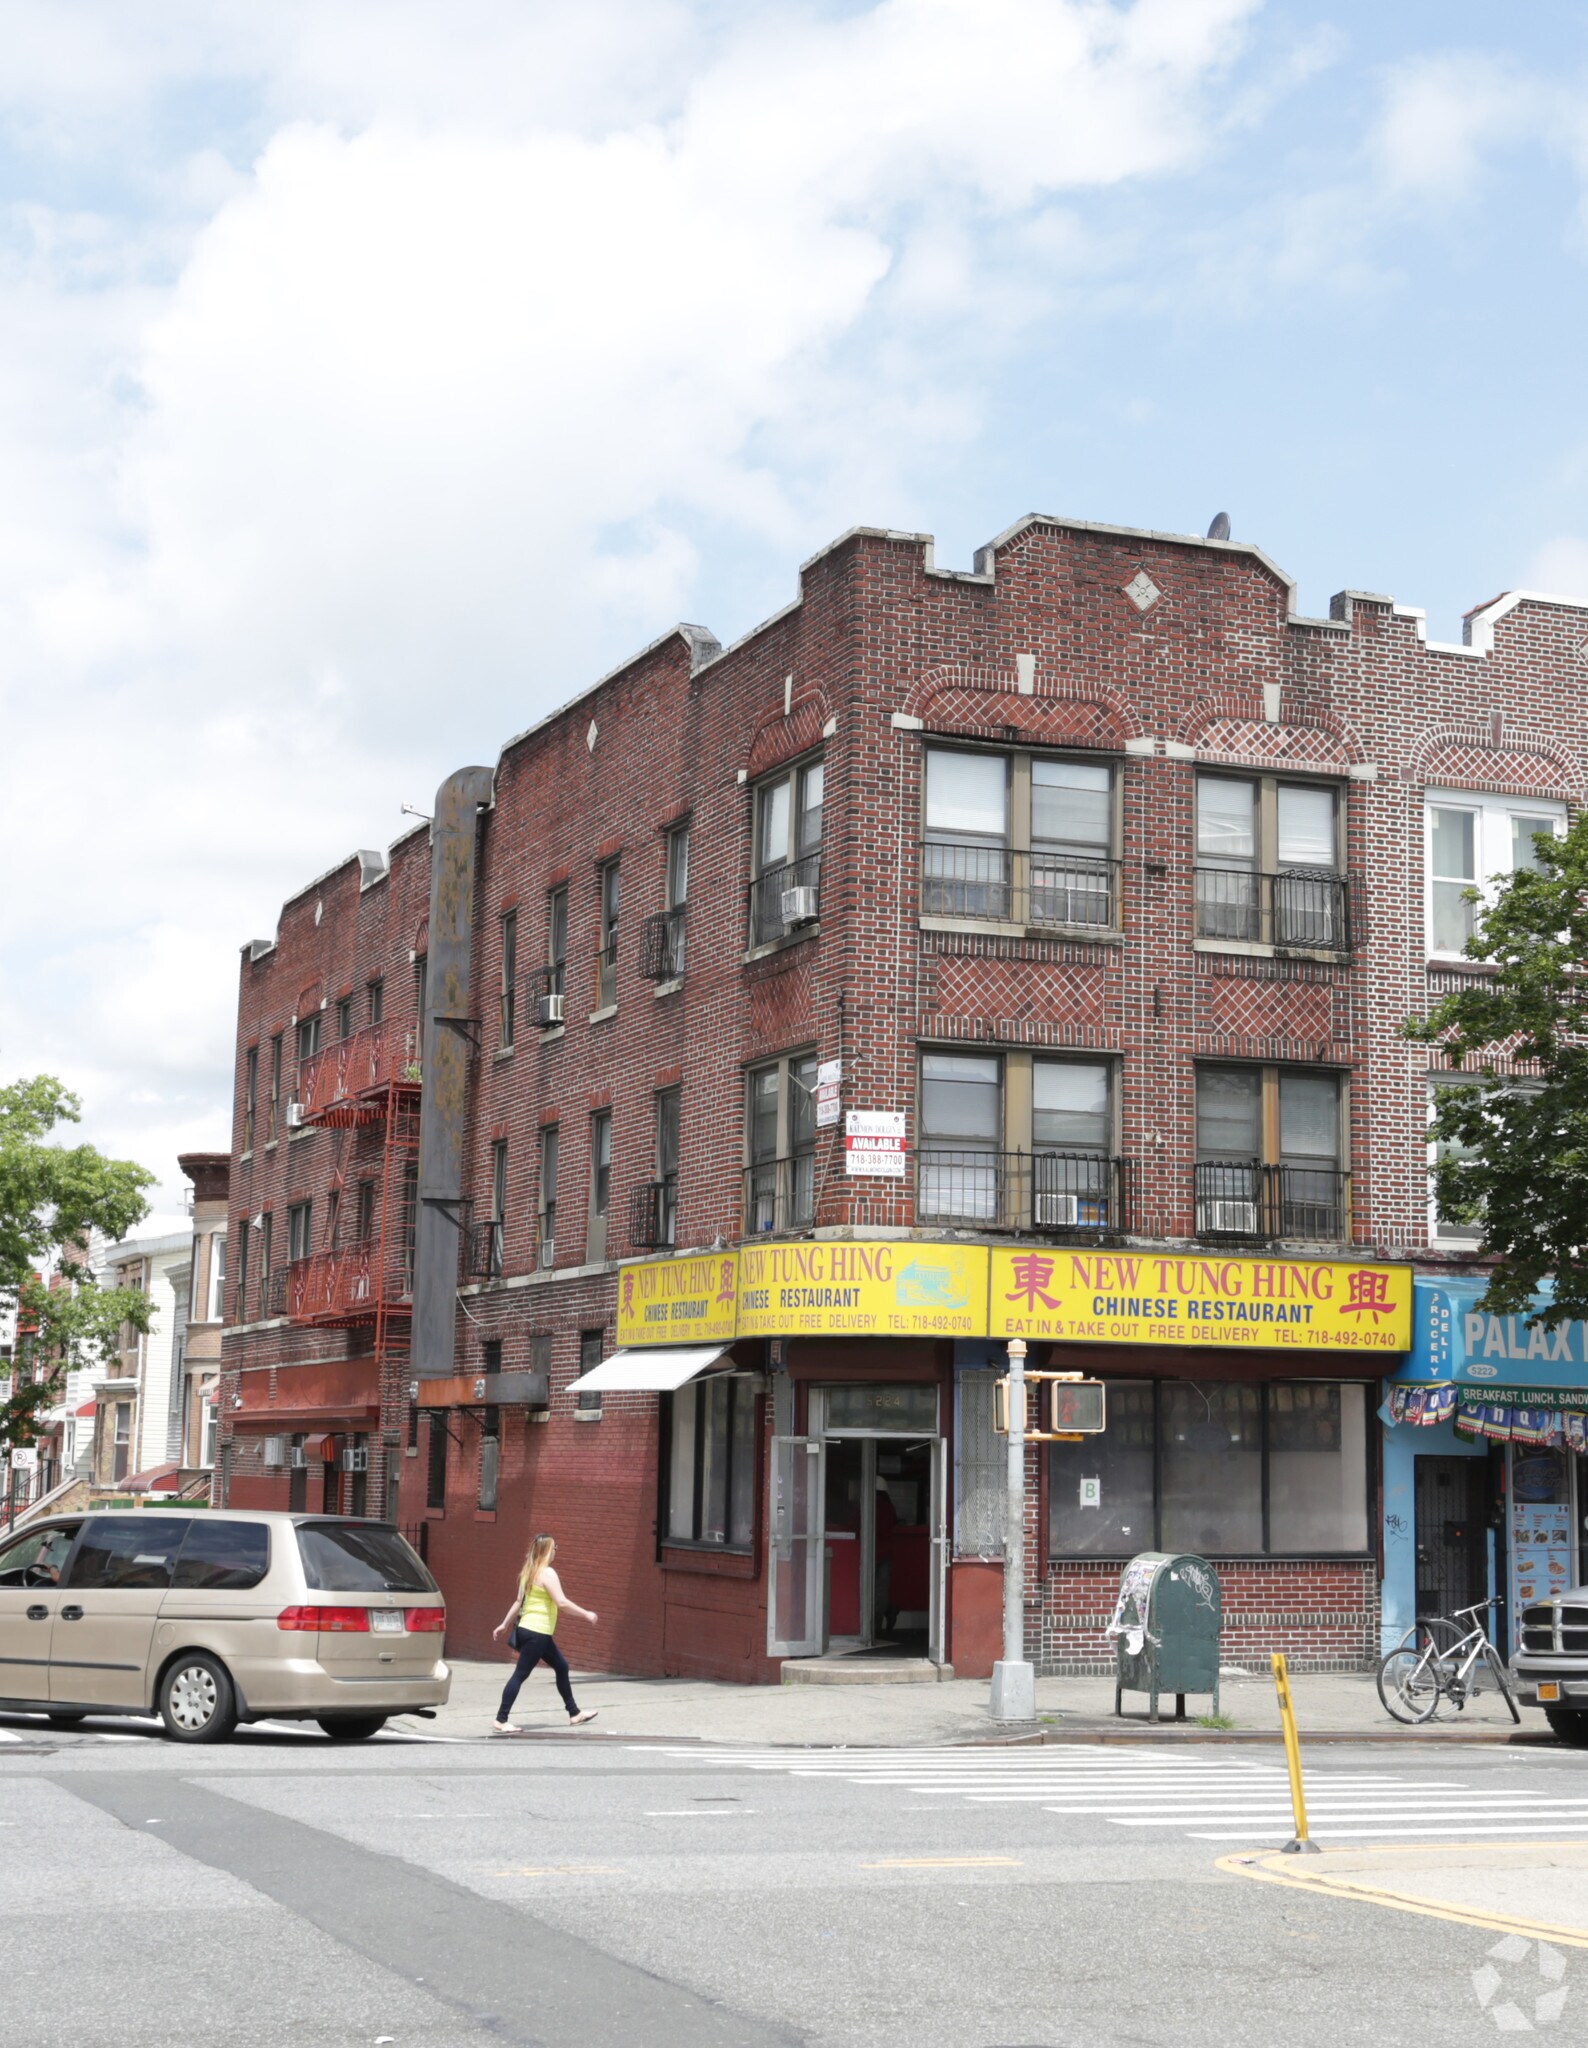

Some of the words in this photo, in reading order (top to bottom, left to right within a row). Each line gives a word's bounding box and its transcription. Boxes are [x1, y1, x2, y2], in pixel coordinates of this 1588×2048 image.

[851, 1154, 902, 1165] 718-388-7700
[637, 1266, 659, 1299] NEW
[661, 1262, 688, 1297] TUNG
[689, 1259, 716, 1294] HING
[743, 1250, 767, 1285] NEW
[770, 1246, 824, 1282] TUNG
[829, 1246, 892, 1282] HING
[1005, 1252, 1062, 1313] 東
[1069, 1255, 1144, 1292] NEW
[1152, 1259, 1243, 1297] TUNG
[1252, 1264, 1333, 1300] HING
[621, 1271, 635, 1323] 東
[645, 1303, 668, 1322] CHINESE
[671, 1300, 708, 1320] RESTAURANT
[743, 1289, 769, 1310] CHINESE
[780, 1288, 860, 1308] RESTAURANT
[1093, 1295, 1178, 1318] CHINESE
[1187, 1300, 1313, 1324] RESTAURANT
[1339, 1269, 1397, 1325] 興
[759, 1315, 776, 1329] TAKE
[778, 1314, 794, 1328] OUT
[799, 1314, 822, 1328] FREE
[829, 1314, 877, 1329] DELIVERY
[888, 1315, 909, 1329] TEL:
[912, 1315, 972, 1330] 718-492-0740
[1005, 1317, 1033, 1333] EAT
[1037, 1319, 1051, 1334] IN
[1055, 1320, 1064, 1334] &
[1068, 1320, 1105, 1336] TAKE
[1110, 1322, 1139, 1337] OUT
[1149, 1324, 1185, 1339] FREE
[1191, 1325, 1259, 1341] DELIVERY
[1274, 1328, 1302, 1343] TEL:
[1307, 1330, 1396, 1347] 718-492-0740
[1441, 1309, 1449, 1360] DELI
[1465, 1313, 1574, 1362] PALAX
[1471, 1367, 1494, 1376] 5222
[1086, 1482, 1096, 1498] B
